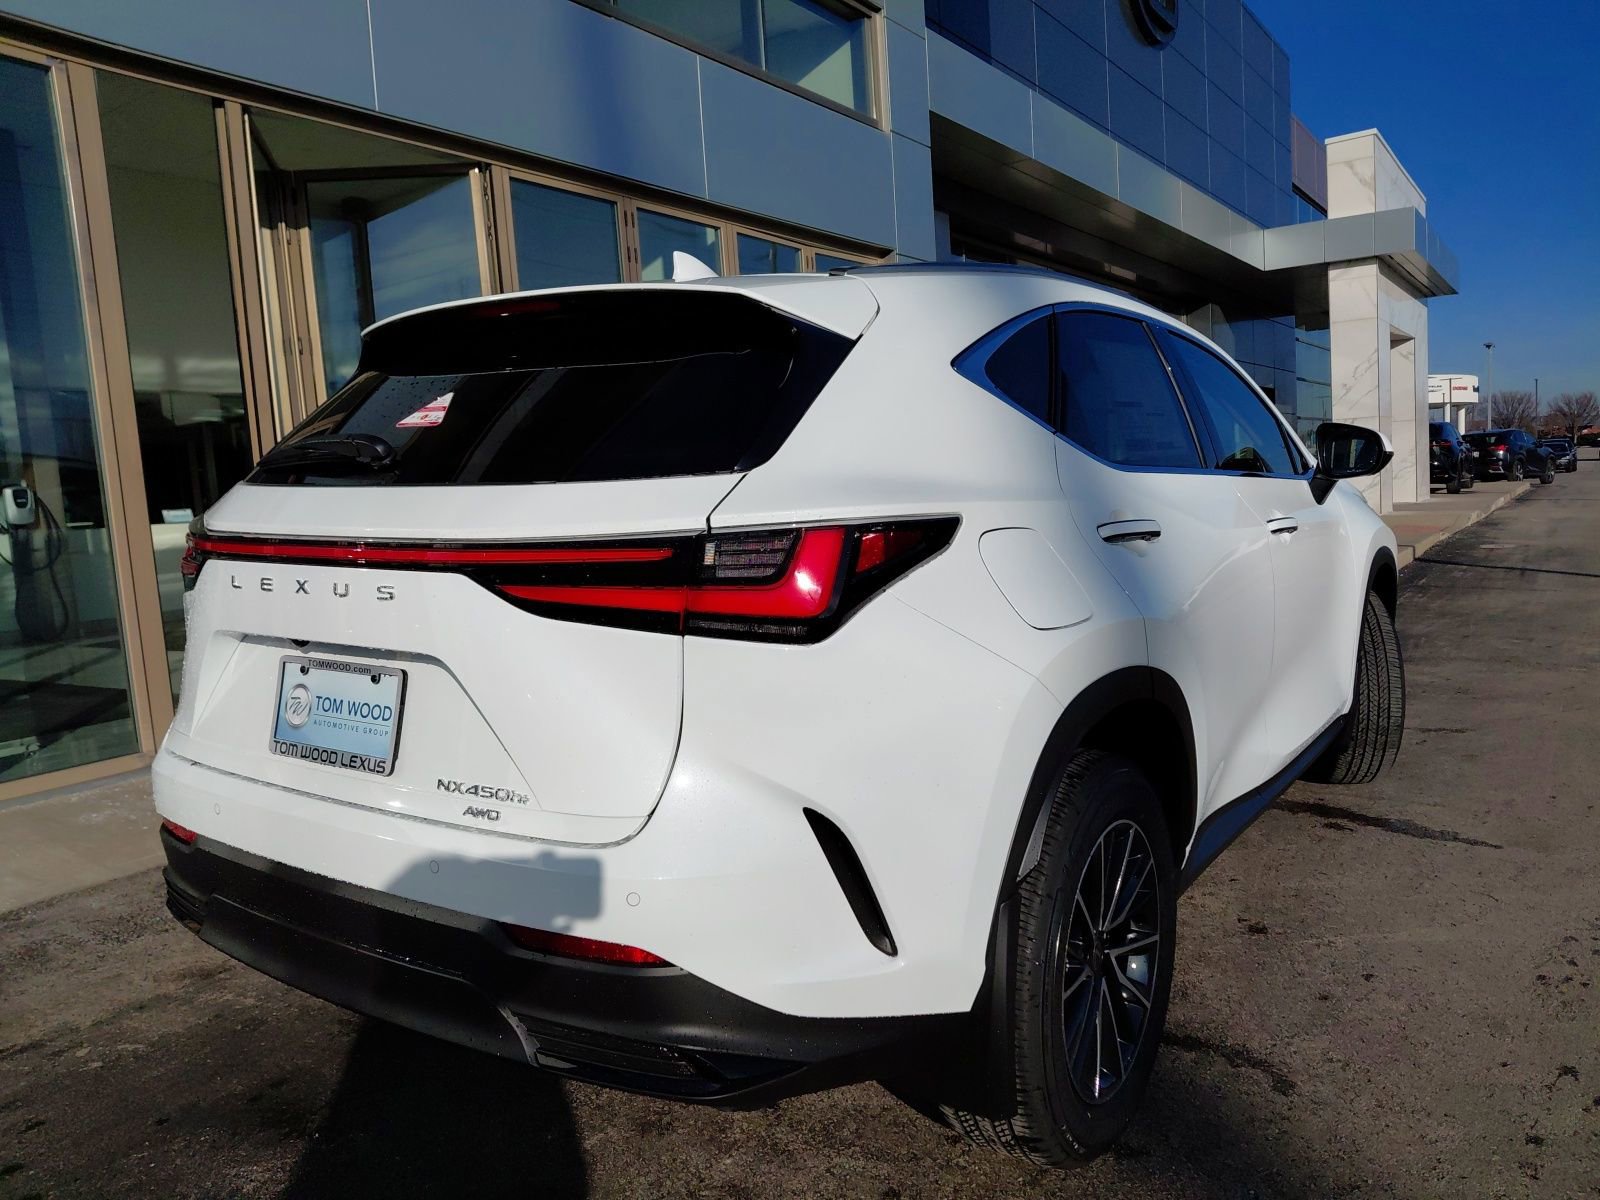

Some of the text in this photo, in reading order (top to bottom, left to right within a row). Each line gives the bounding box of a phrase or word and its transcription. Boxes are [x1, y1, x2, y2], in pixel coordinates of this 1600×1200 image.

[231, 575, 395, 601] LEXUS
[308, 659, 372, 675] TOMWOOD.com
[315, 695, 393, 721] TOM WOOD
[313, 719, 389, 737] AUTOMOTIVE GROUP
[300, 747, 338, 765] WOOD
[341, 753, 386, 774] LEXUS
[462, 805, 501, 821] AWD
